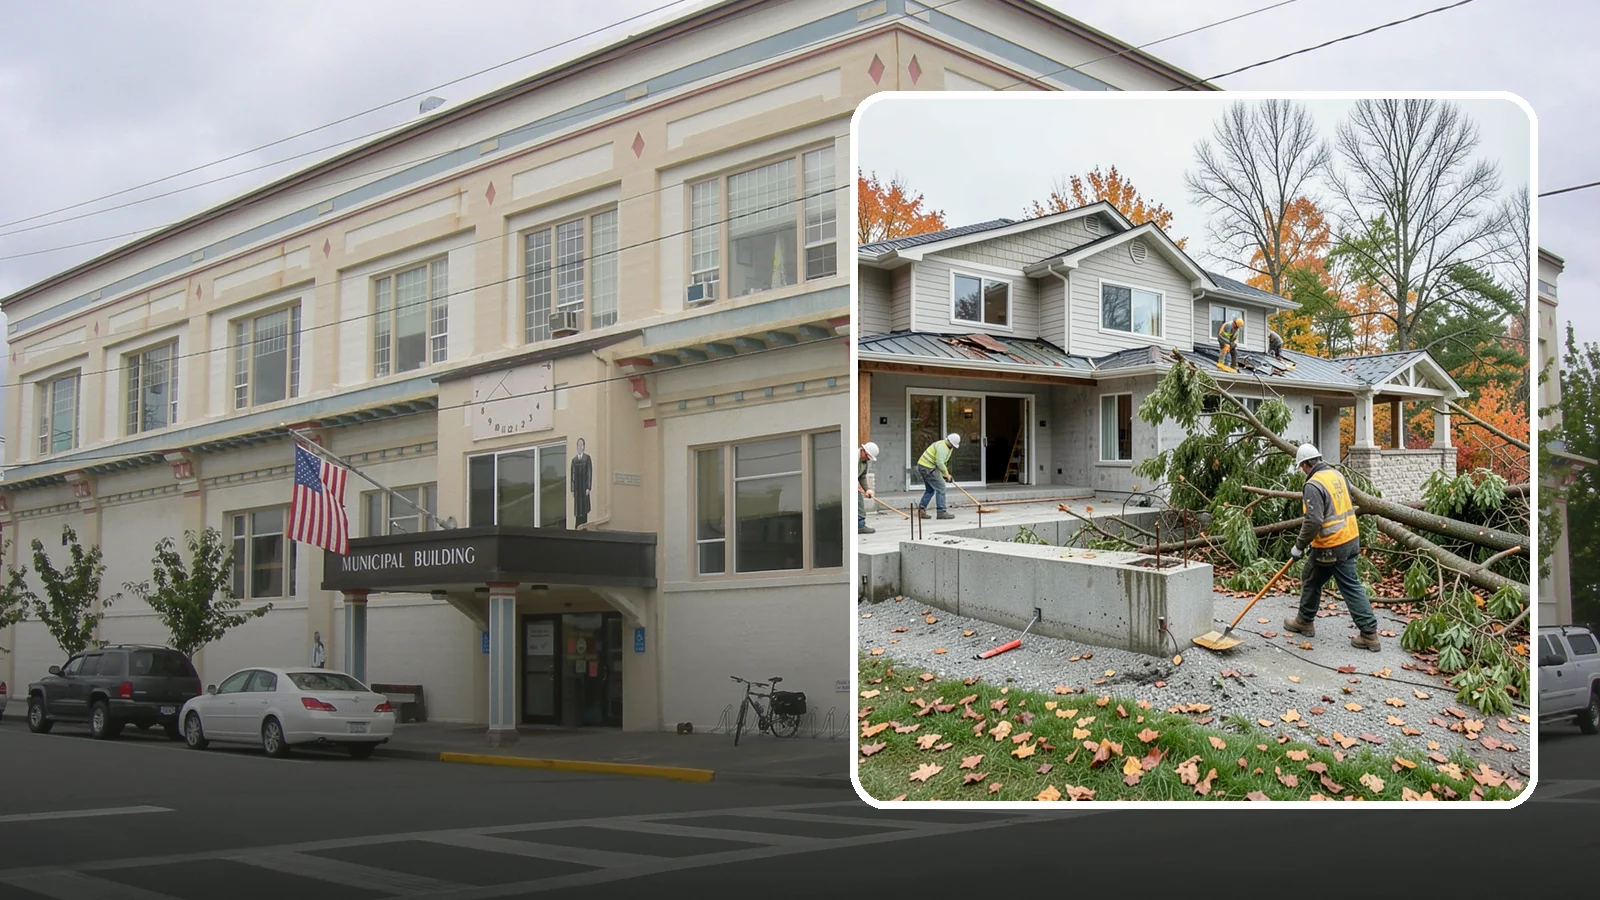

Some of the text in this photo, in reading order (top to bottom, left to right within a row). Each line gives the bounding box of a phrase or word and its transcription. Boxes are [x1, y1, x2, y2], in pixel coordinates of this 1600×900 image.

[488, 417, 492, 426] 9
[521, 420, 526, 428] 2
[342, 546, 475, 572] MUNICIPAL BUILDING
